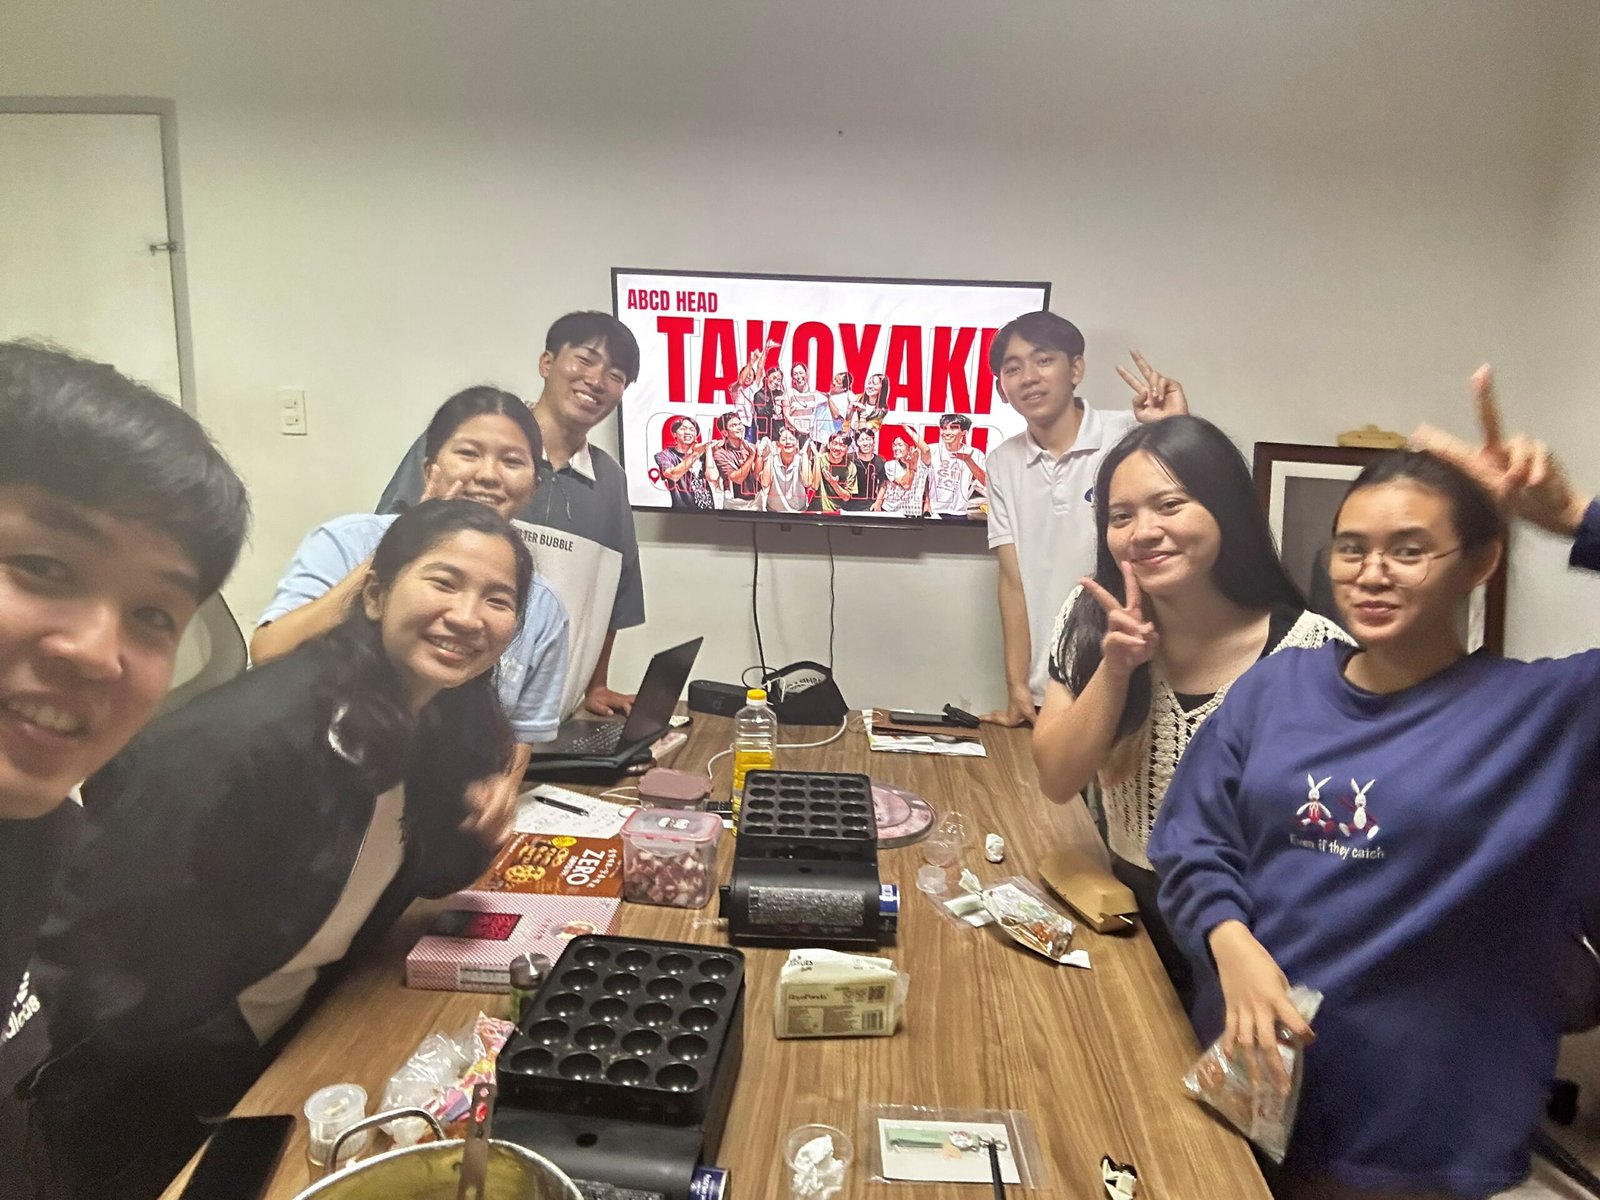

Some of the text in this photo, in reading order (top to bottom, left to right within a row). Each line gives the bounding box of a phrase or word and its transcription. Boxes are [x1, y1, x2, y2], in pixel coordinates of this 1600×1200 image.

[627, 288, 718, 313] ABCD HEAD
[540, 534, 573, 552] BUBBLE
[1318, 839, 1328, 852] if
[1329, 840, 1350, 860] they
[1352, 847, 1385, 860] catch
[566, 848, 606, 886] ZERO
